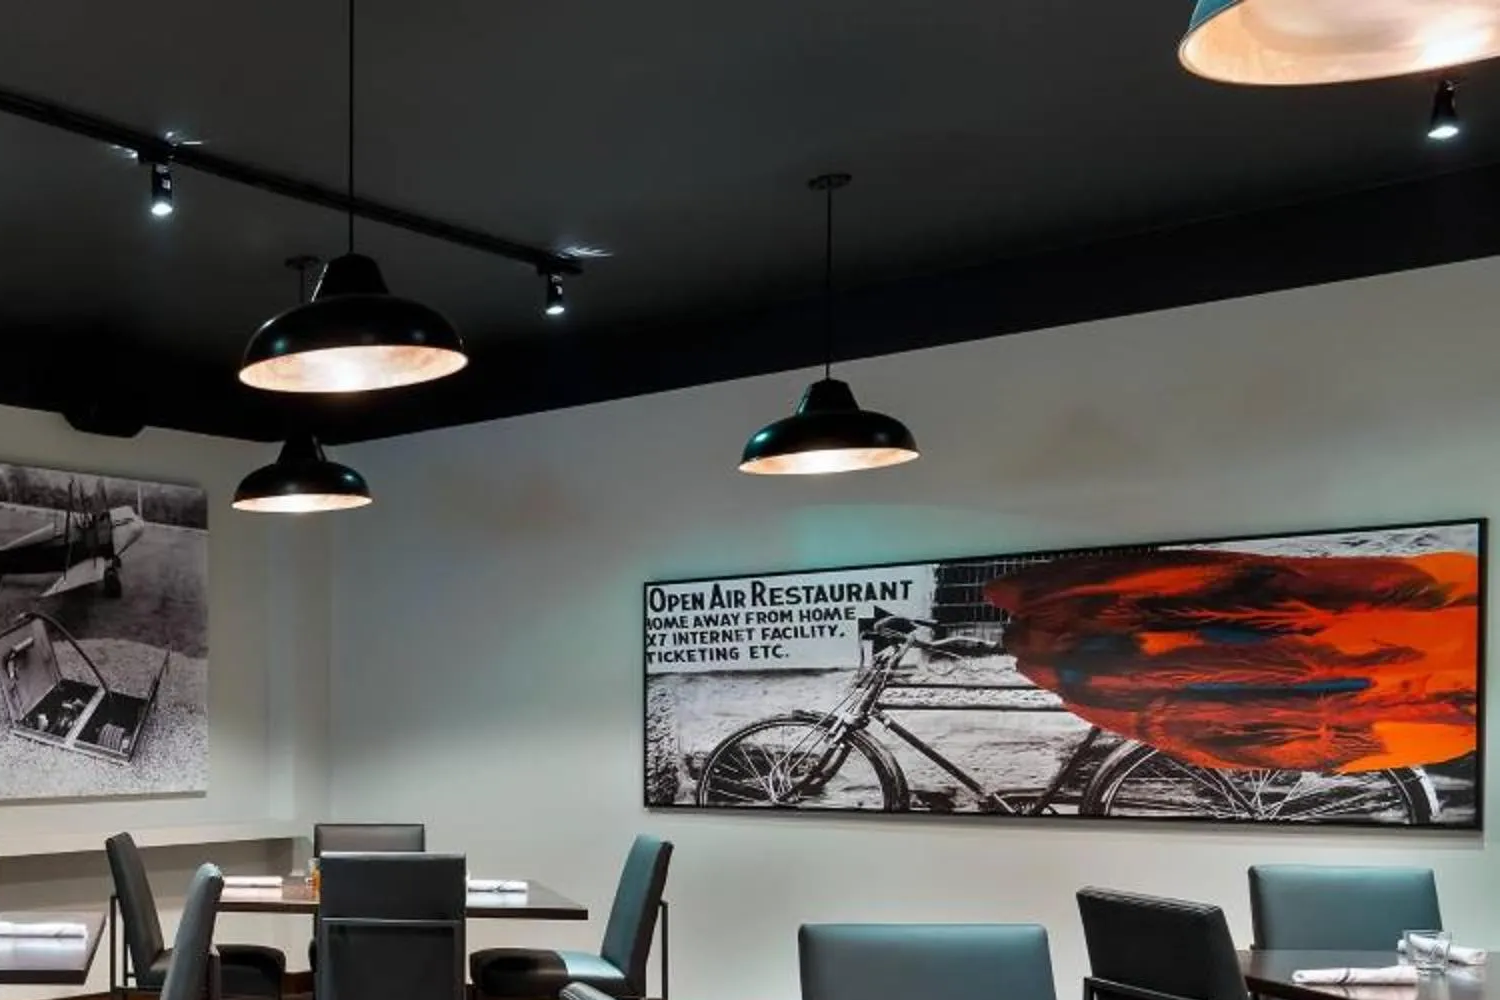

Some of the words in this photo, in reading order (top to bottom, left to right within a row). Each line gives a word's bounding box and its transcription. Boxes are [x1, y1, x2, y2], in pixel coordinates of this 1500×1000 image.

[694, 612, 739, 628] AWAY
[746, 610, 793, 624] FROM
[799, 607, 856, 622] HOME
[673, 628, 754, 646] INTERNET
[762, 625, 845, 640] FACILITY.
[646, 647, 739, 664] TICKETING
[750, 645, 789, 659] ETC.
